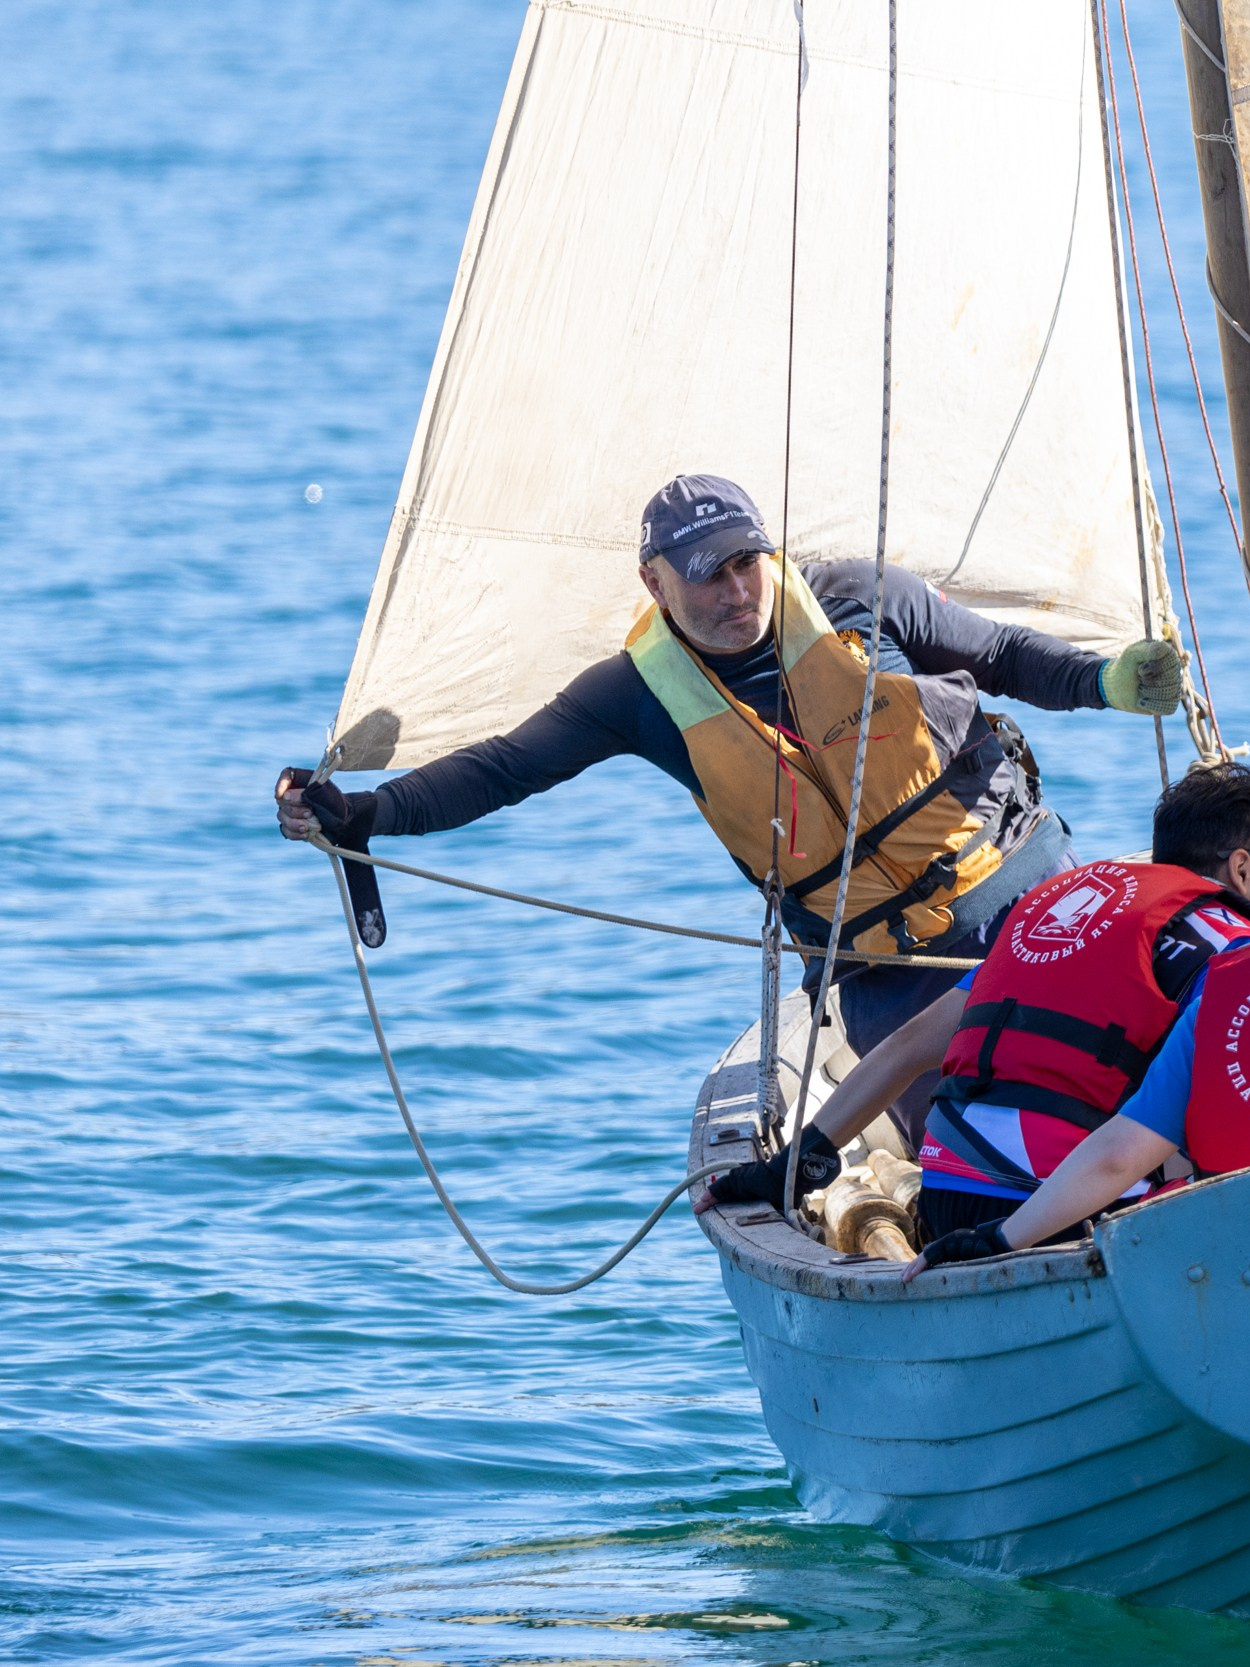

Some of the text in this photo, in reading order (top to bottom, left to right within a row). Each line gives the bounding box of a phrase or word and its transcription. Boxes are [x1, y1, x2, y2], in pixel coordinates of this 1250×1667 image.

[848, 695, 889, 726] LAING
[1024, 864, 1139, 916] АССОЦИАЦИЯ КЛАССА
[1011, 919, 1113, 964] ПЛАСТИКОВЫЙ ЯЛ
